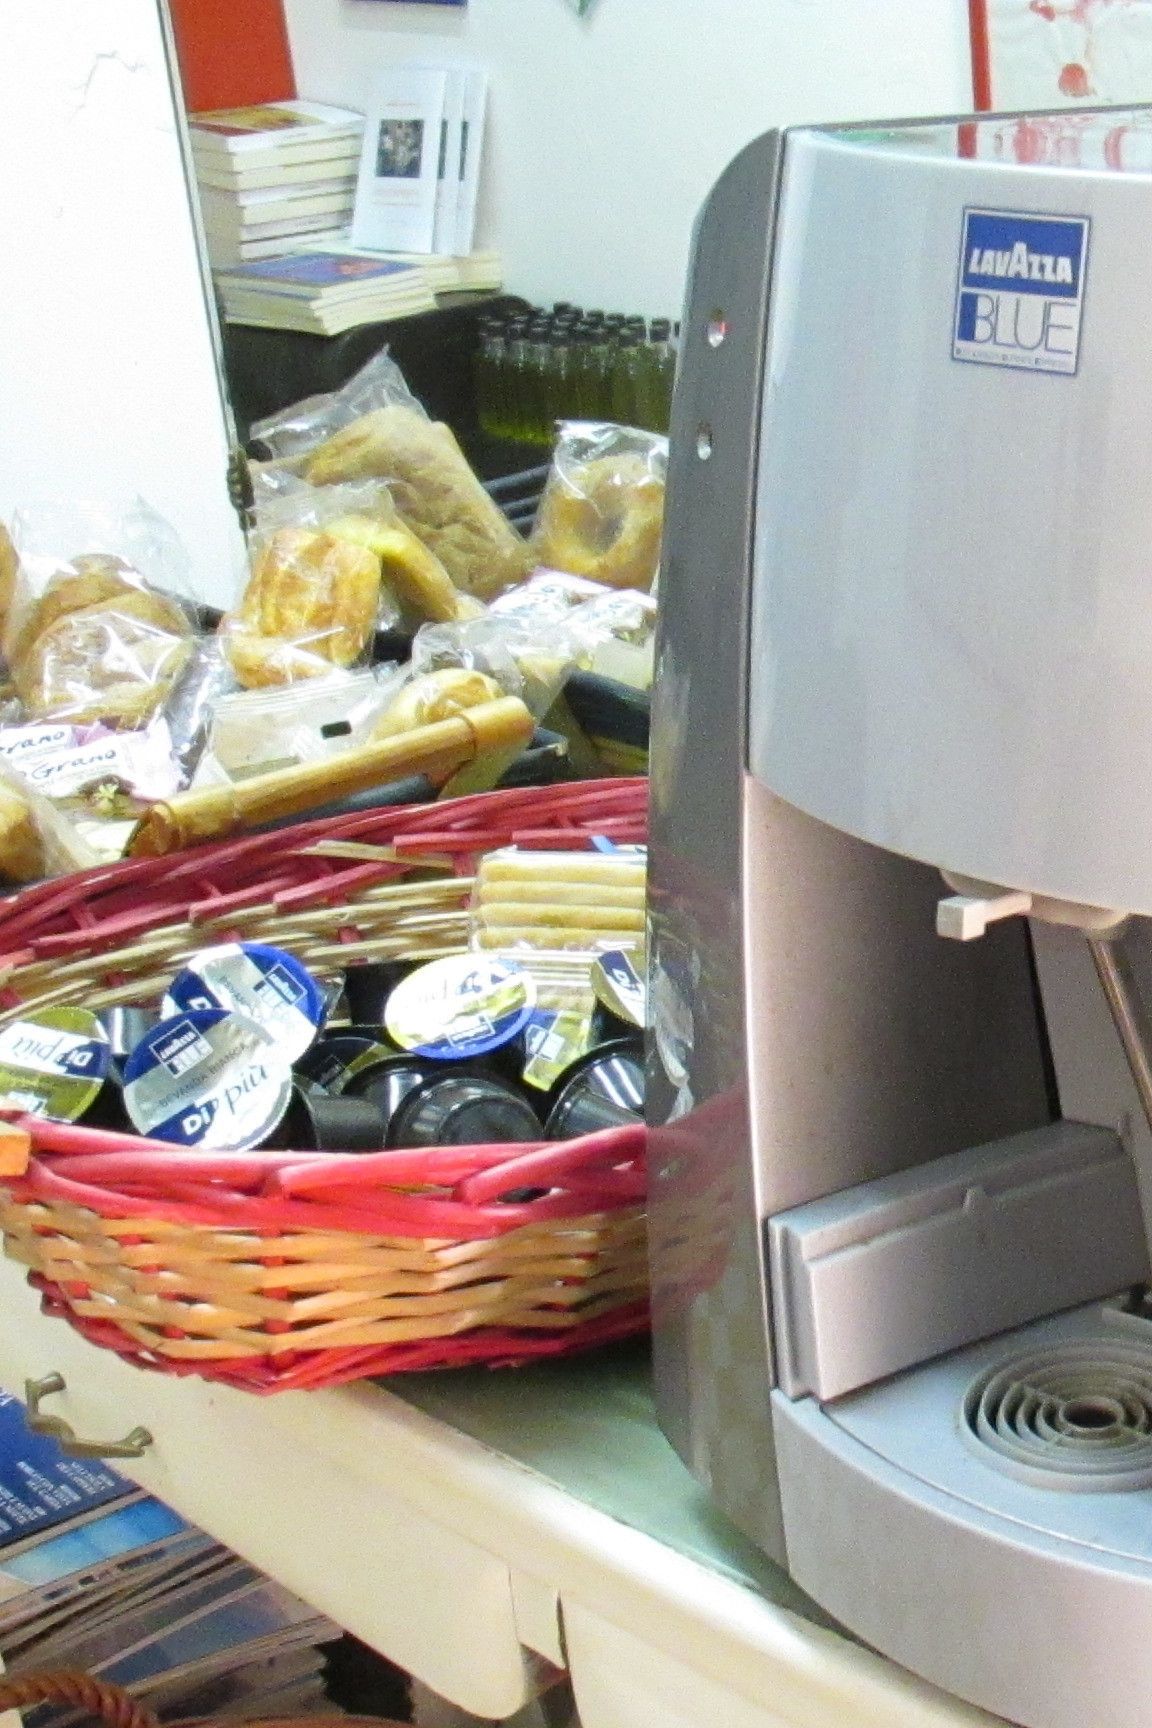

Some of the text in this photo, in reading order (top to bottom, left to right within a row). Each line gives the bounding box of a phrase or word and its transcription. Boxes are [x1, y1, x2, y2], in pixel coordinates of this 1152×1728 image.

[968, 241, 1073, 284] LAVAZZA
[957, 293, 1077, 354] BLUE
[31, 749, 116, 780] Grano
[224, 1064, 267, 1116] più
